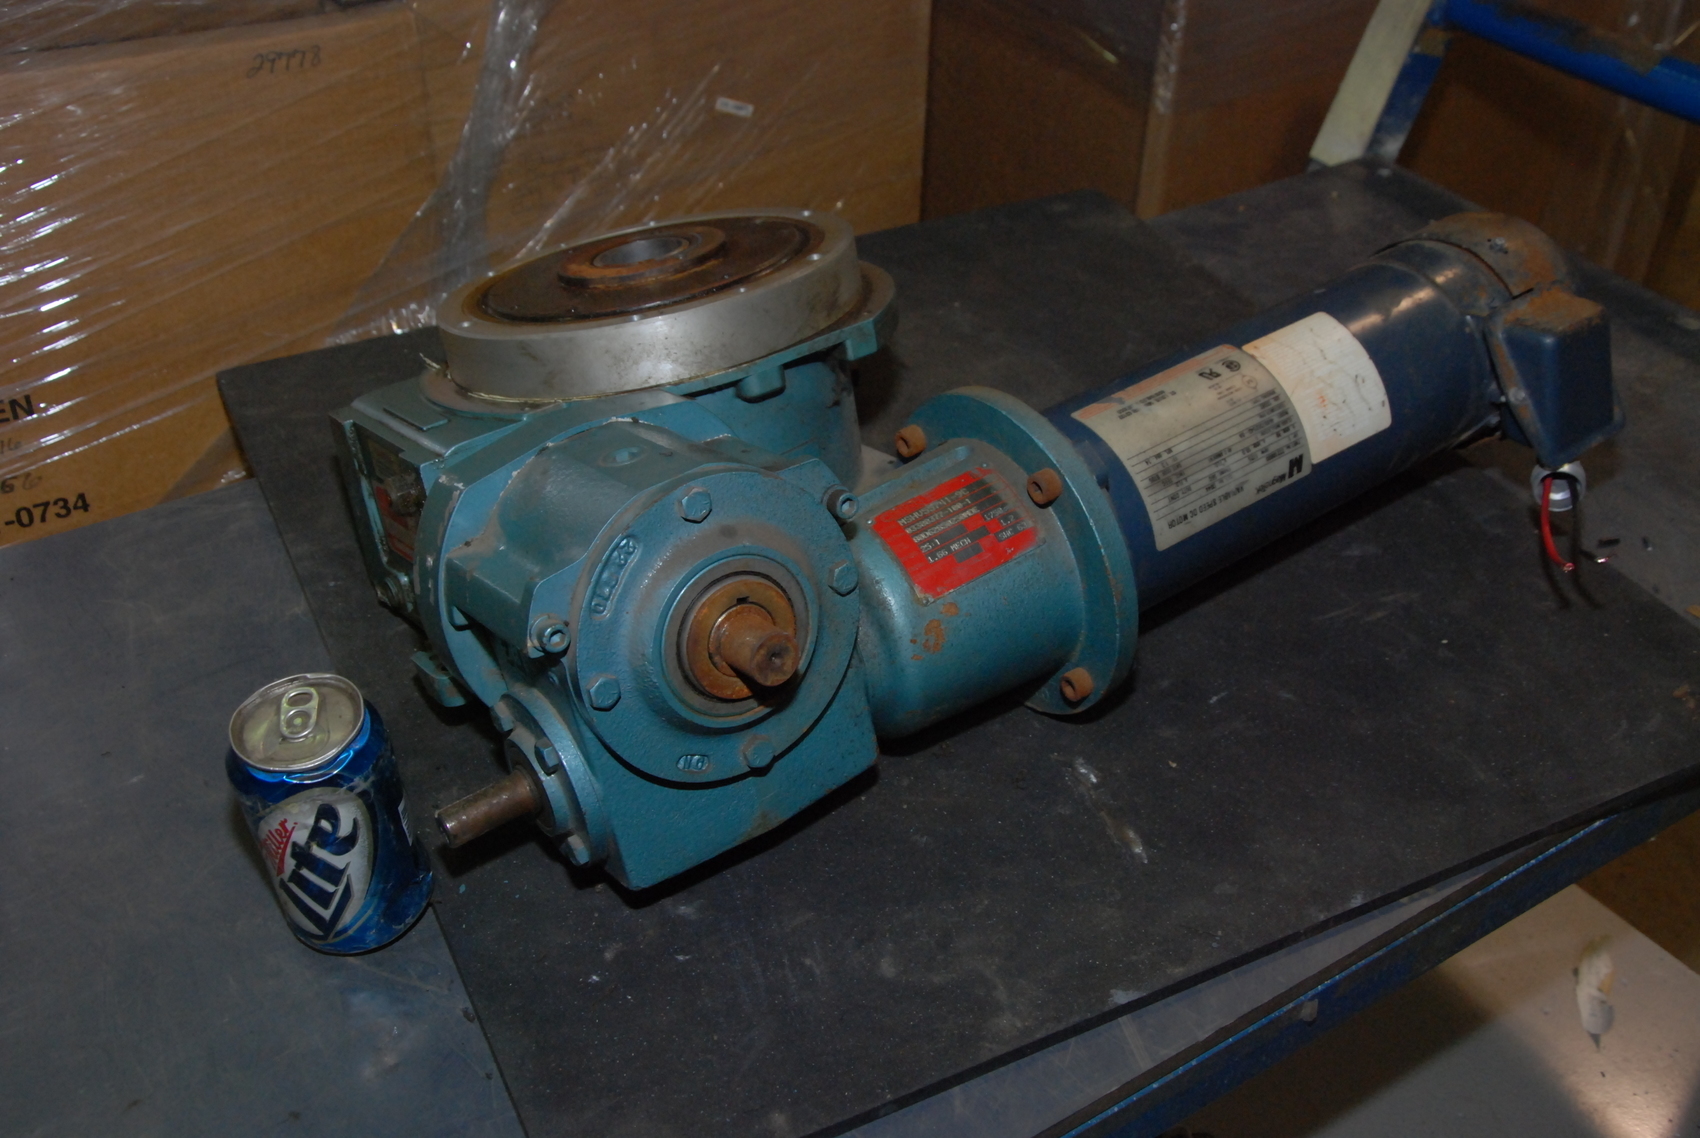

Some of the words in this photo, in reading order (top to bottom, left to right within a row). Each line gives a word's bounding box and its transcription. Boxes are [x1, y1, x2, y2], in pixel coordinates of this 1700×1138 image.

[4, 492, 90, 528] -0734
[1187, 507, 1199, 518] DC
[1196, 497, 1218, 513] SPEED
[1166, 512, 1189, 530] MOTOR
